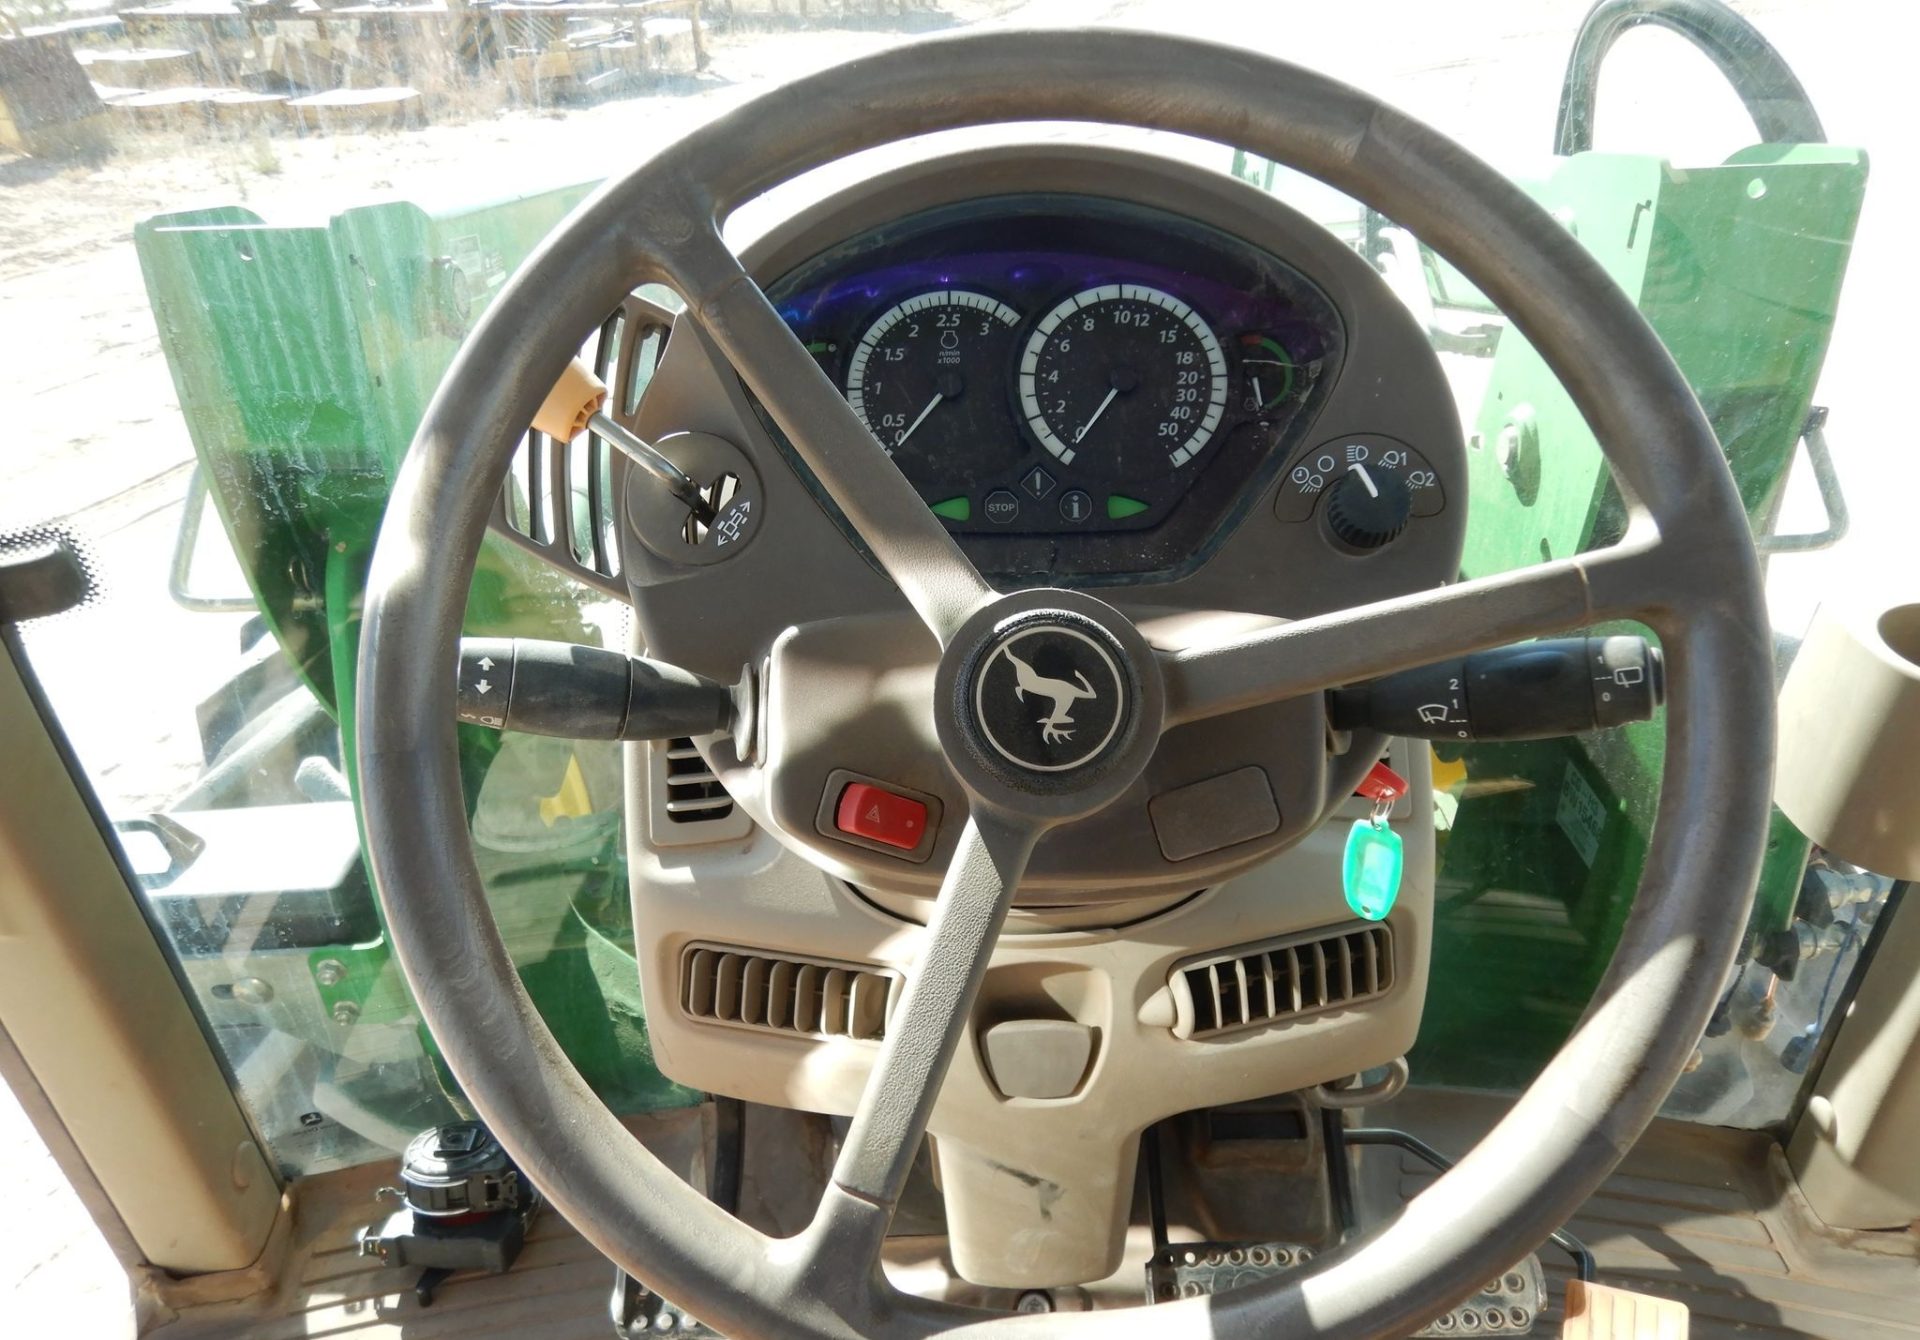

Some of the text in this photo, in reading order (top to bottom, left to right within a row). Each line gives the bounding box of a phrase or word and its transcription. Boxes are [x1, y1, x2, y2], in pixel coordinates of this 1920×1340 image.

[936, 314, 961, 327] 2.5
[1113, 310, 1131, 324] 10
[1133, 313, 1150, 327] 12
[908, 325, 920, 338] 2
[979, 323, 990, 336] 3
[1083, 318, 1095, 332] 8
[1159, 329, 1178, 343] 15
[1060, 338, 1070, 352] 6
[884, 348, 904, 361] 1.5
[1175, 351, 1194, 365] 18
[1049, 370, 1059, 383] 4
[1176, 371, 1198, 385] 20
[875, 382, 882, 395] 1
[1176, 388, 1197, 402] 30
[1056, 400, 1066, 414] 2
[1169, 406, 1190, 420] 40
[882, 414, 906, 427] 0.5
[895, 429, 905, 442] 0
[1157, 422, 1179, 436] 50
[1400, 451, 1407, 466] 1
[1425, 472, 1435, 487] 2
[987, 503, 1015, 512] STOP
[1450, 679, 1459, 690] 2
[1452, 699, 1458, 709] 1
